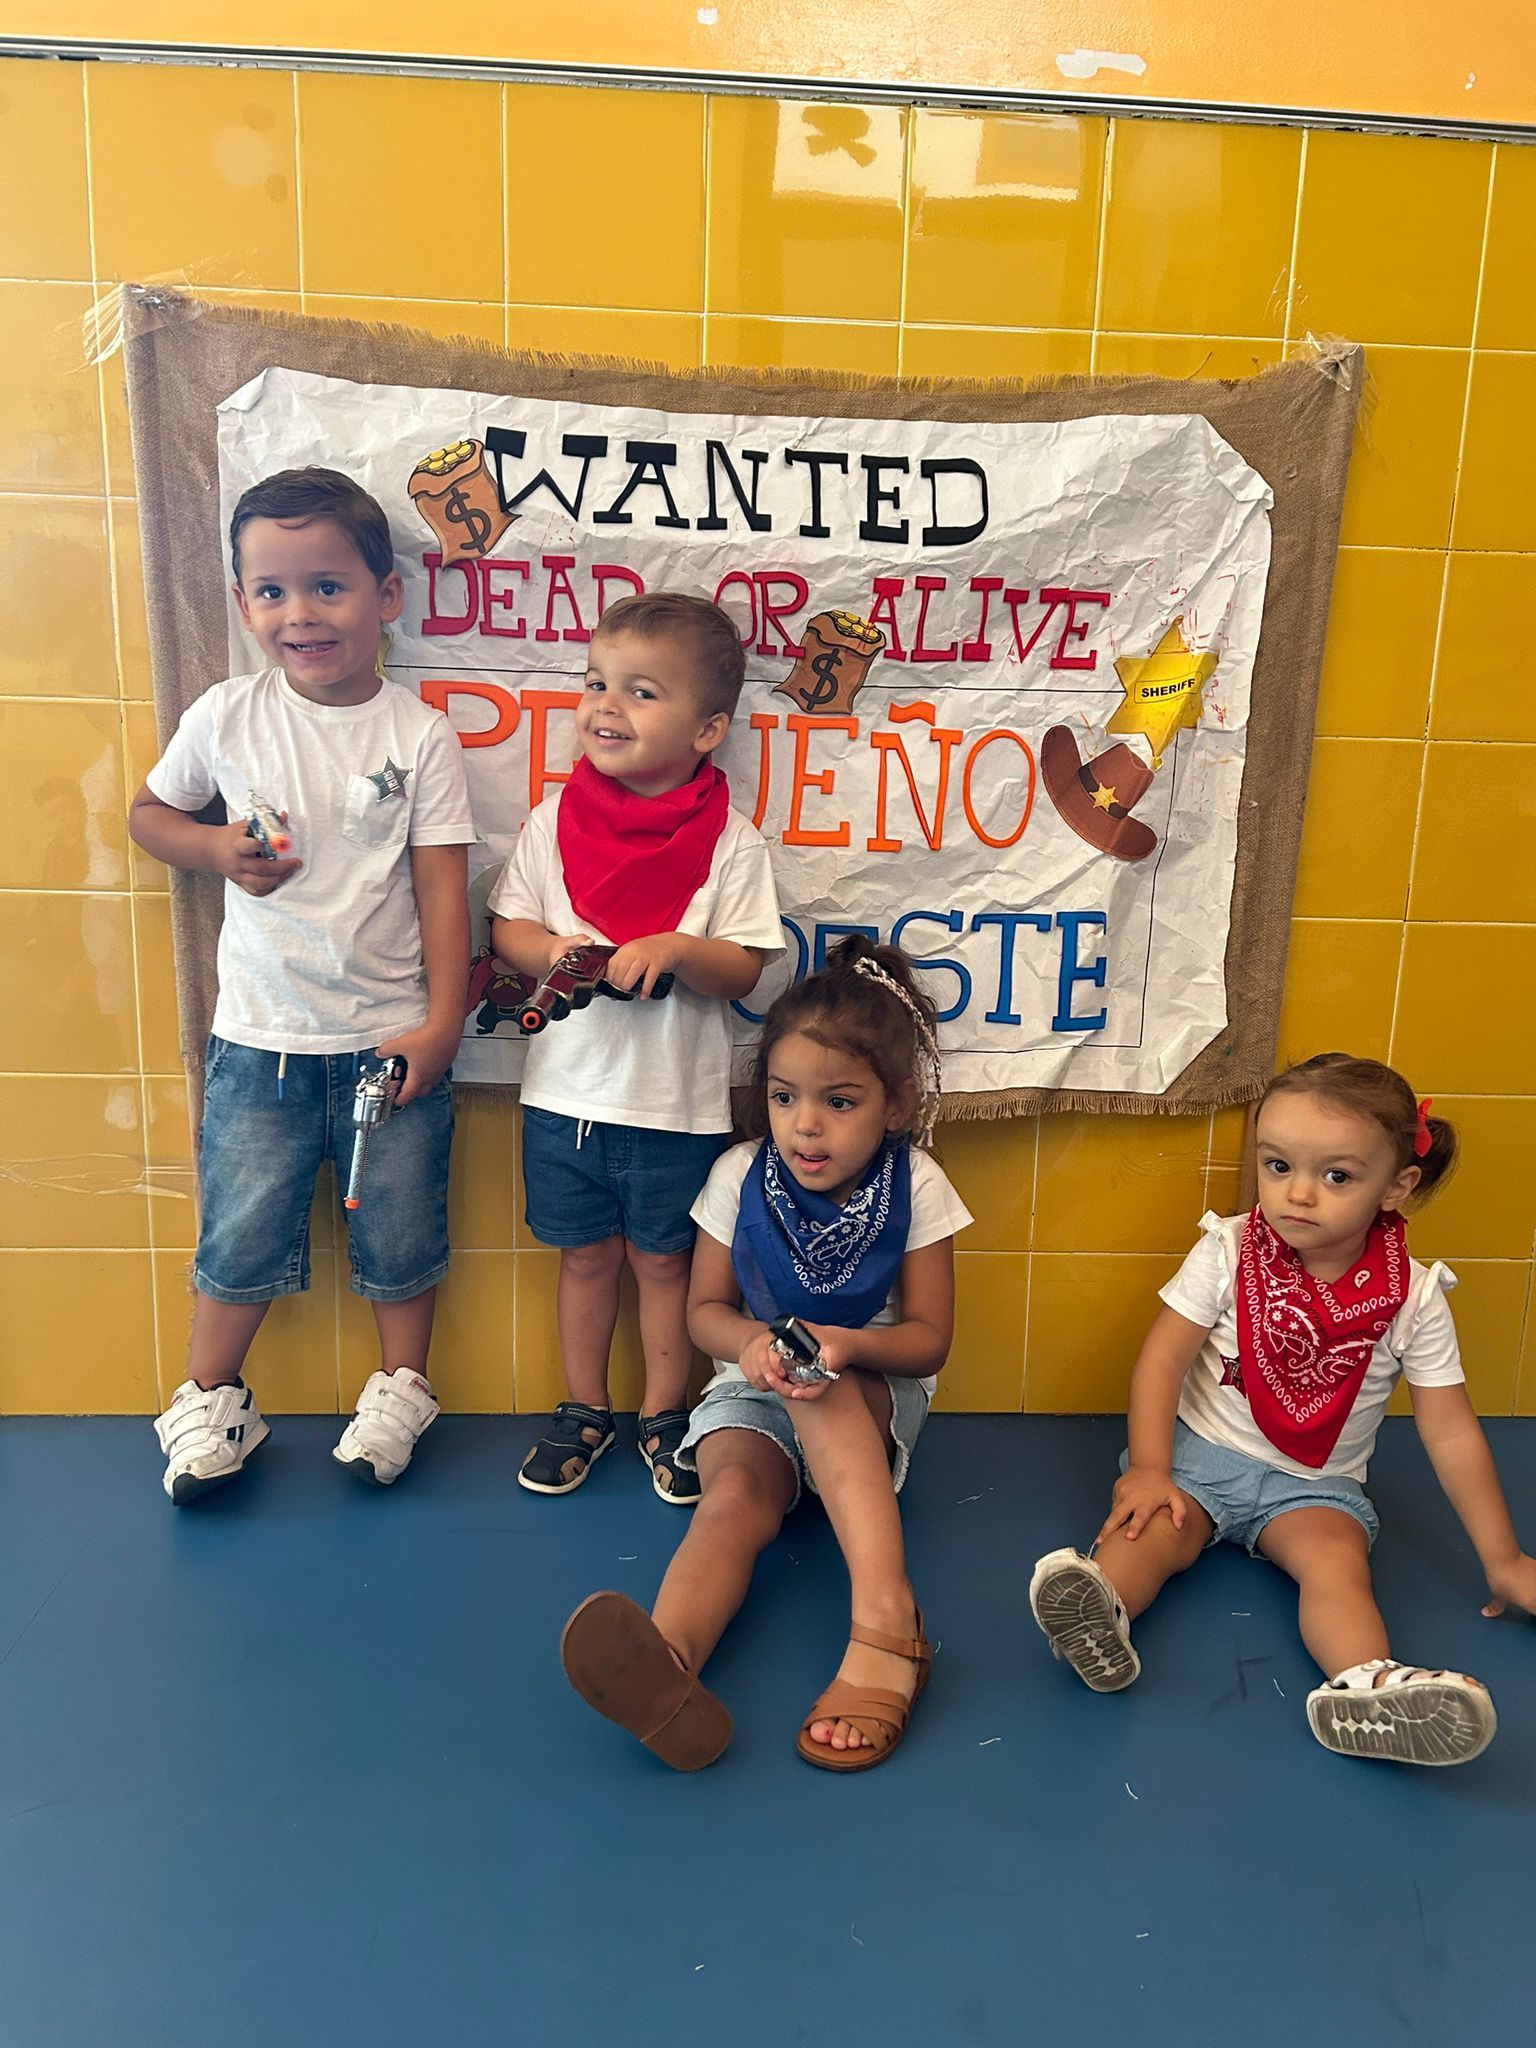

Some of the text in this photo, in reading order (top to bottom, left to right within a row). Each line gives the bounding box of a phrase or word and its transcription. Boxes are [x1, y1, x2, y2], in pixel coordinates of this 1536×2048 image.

[485, 427, 989, 547] WANTED
[714, 571, 809, 659] OR
[868, 576, 1111, 670] ALIVE
[1141, 678, 1196, 698] SHERIFF
